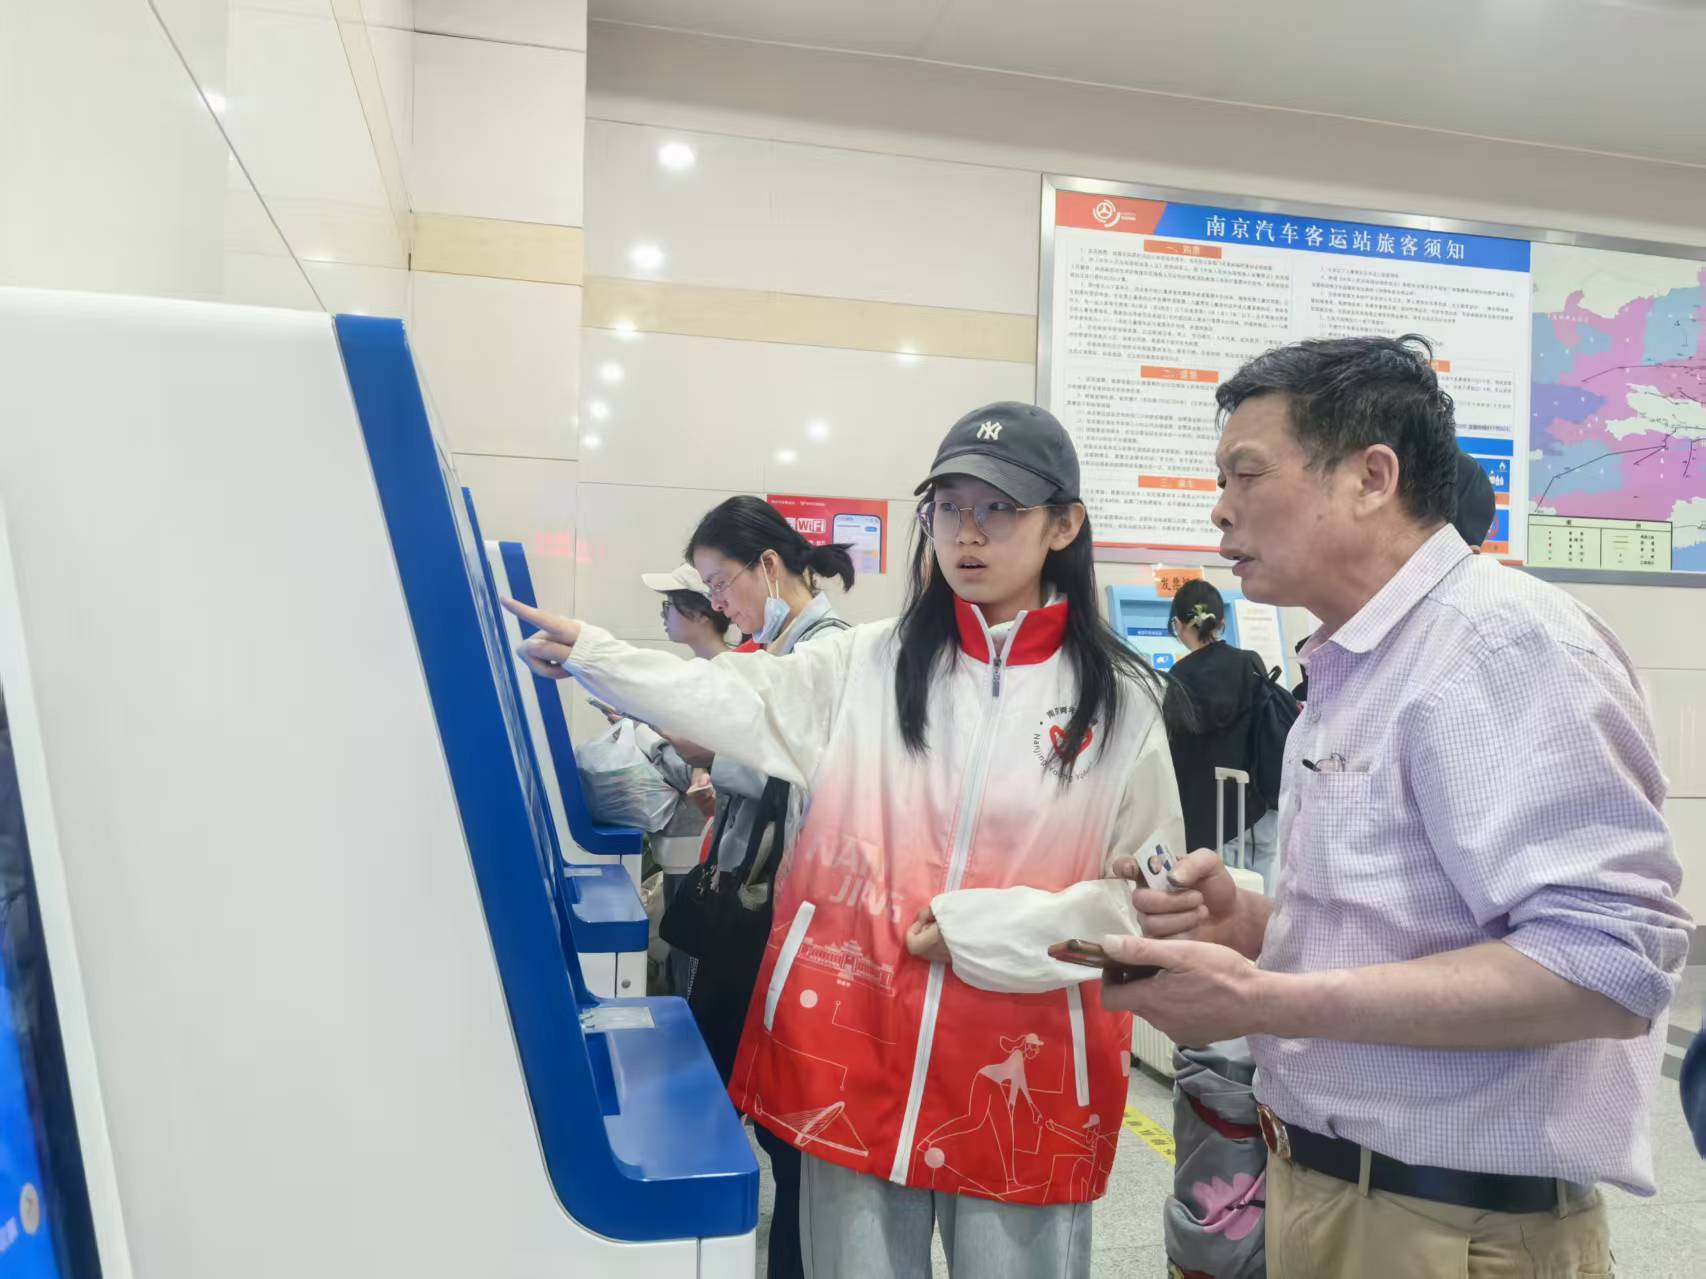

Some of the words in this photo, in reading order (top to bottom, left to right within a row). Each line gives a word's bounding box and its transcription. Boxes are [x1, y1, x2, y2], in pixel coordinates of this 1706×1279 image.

[1205, 214, 1466, 260] 南京汽车客运站旅客须知
